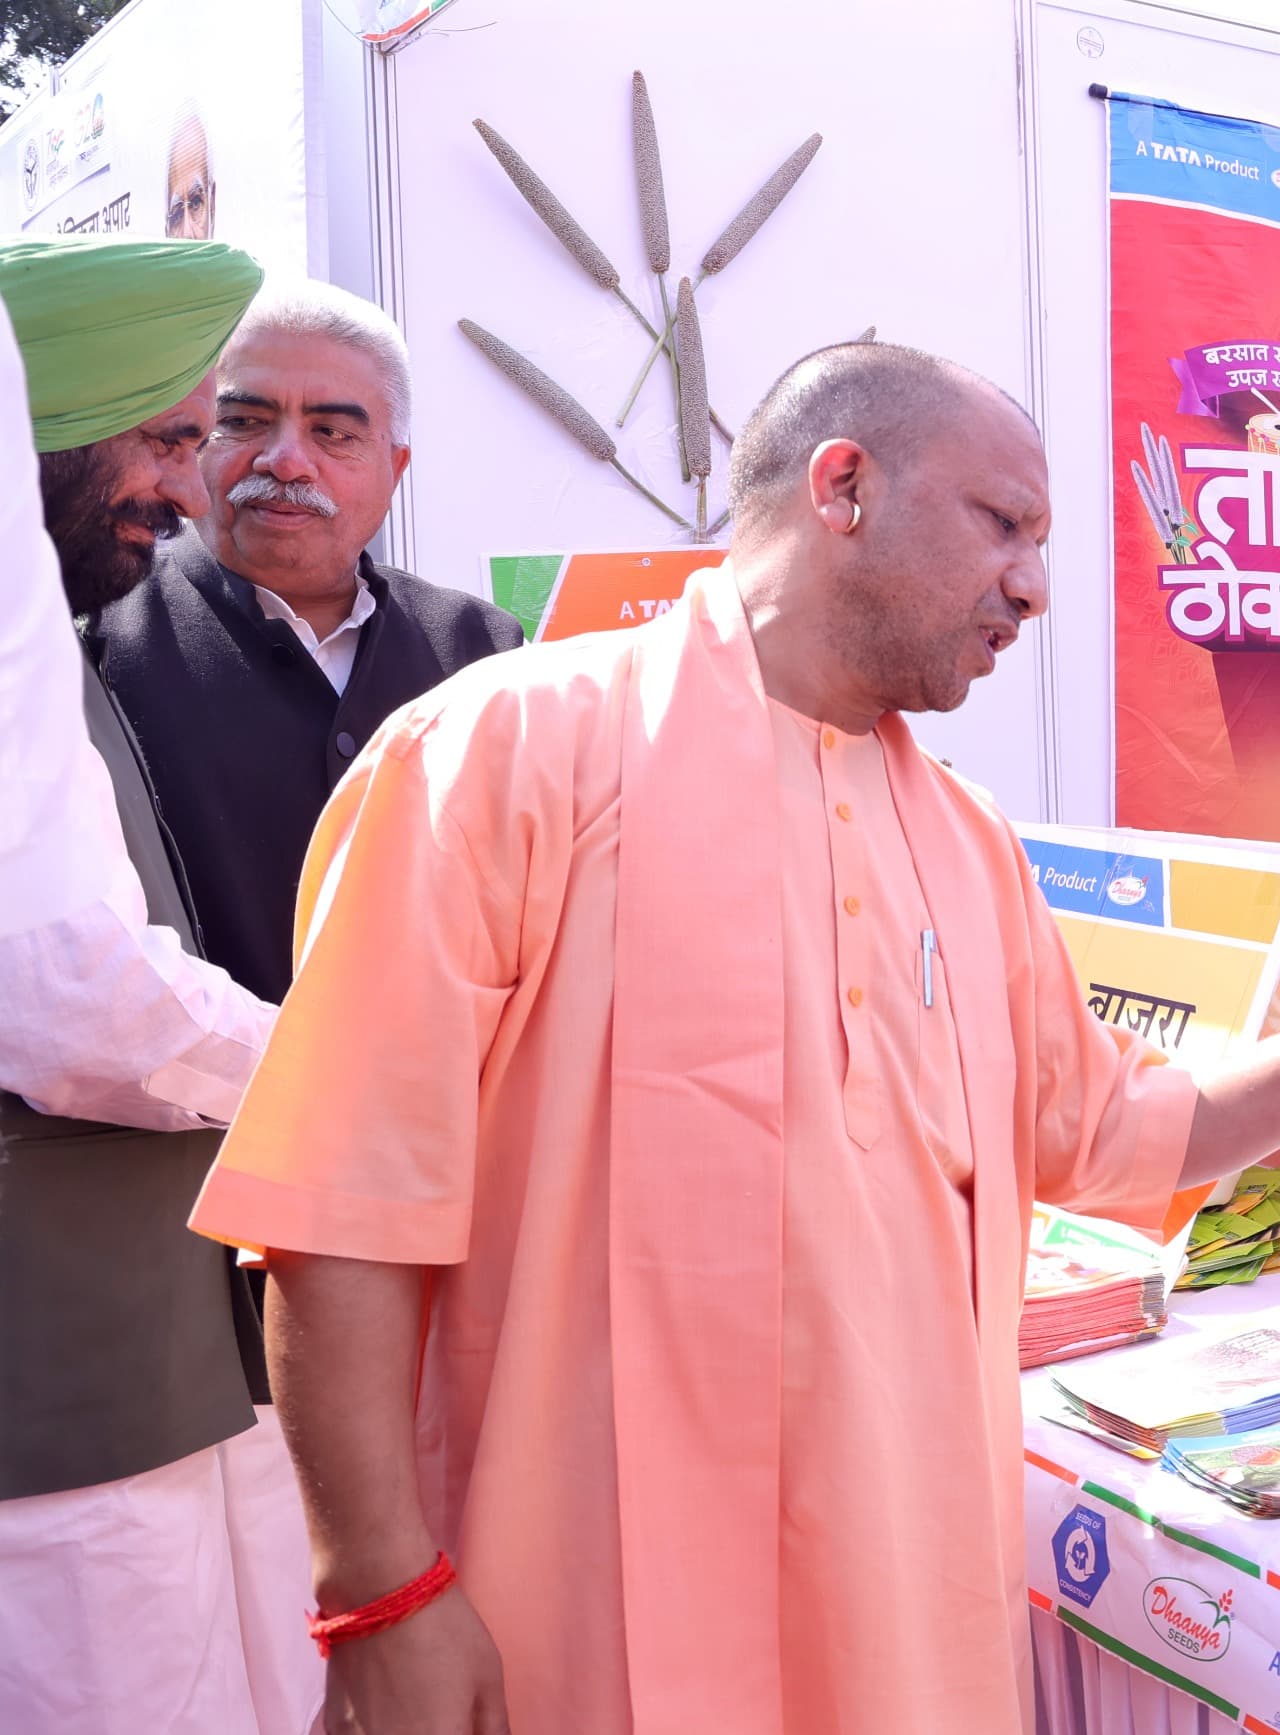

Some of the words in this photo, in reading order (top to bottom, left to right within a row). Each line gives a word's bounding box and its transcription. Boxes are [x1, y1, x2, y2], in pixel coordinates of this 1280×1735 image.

[1136, 141, 1148, 157] A
[1151, 142, 1202, 168] TATA
[1205, 154, 1260, 182] Product
[1203, 344, 1268, 365] बरसात
[1226, 369, 1268, 388] उपज
[620, 601, 636, 620] A
[1044, 867, 1097, 892] Product
[1088, 983, 1196, 1049] बाजरा
[1075, 1512, 1094, 1528] SEEDS
[1151, 1585, 1222, 1650] Dhaanya
[1168, 1628, 1201, 1654] SEEDS
